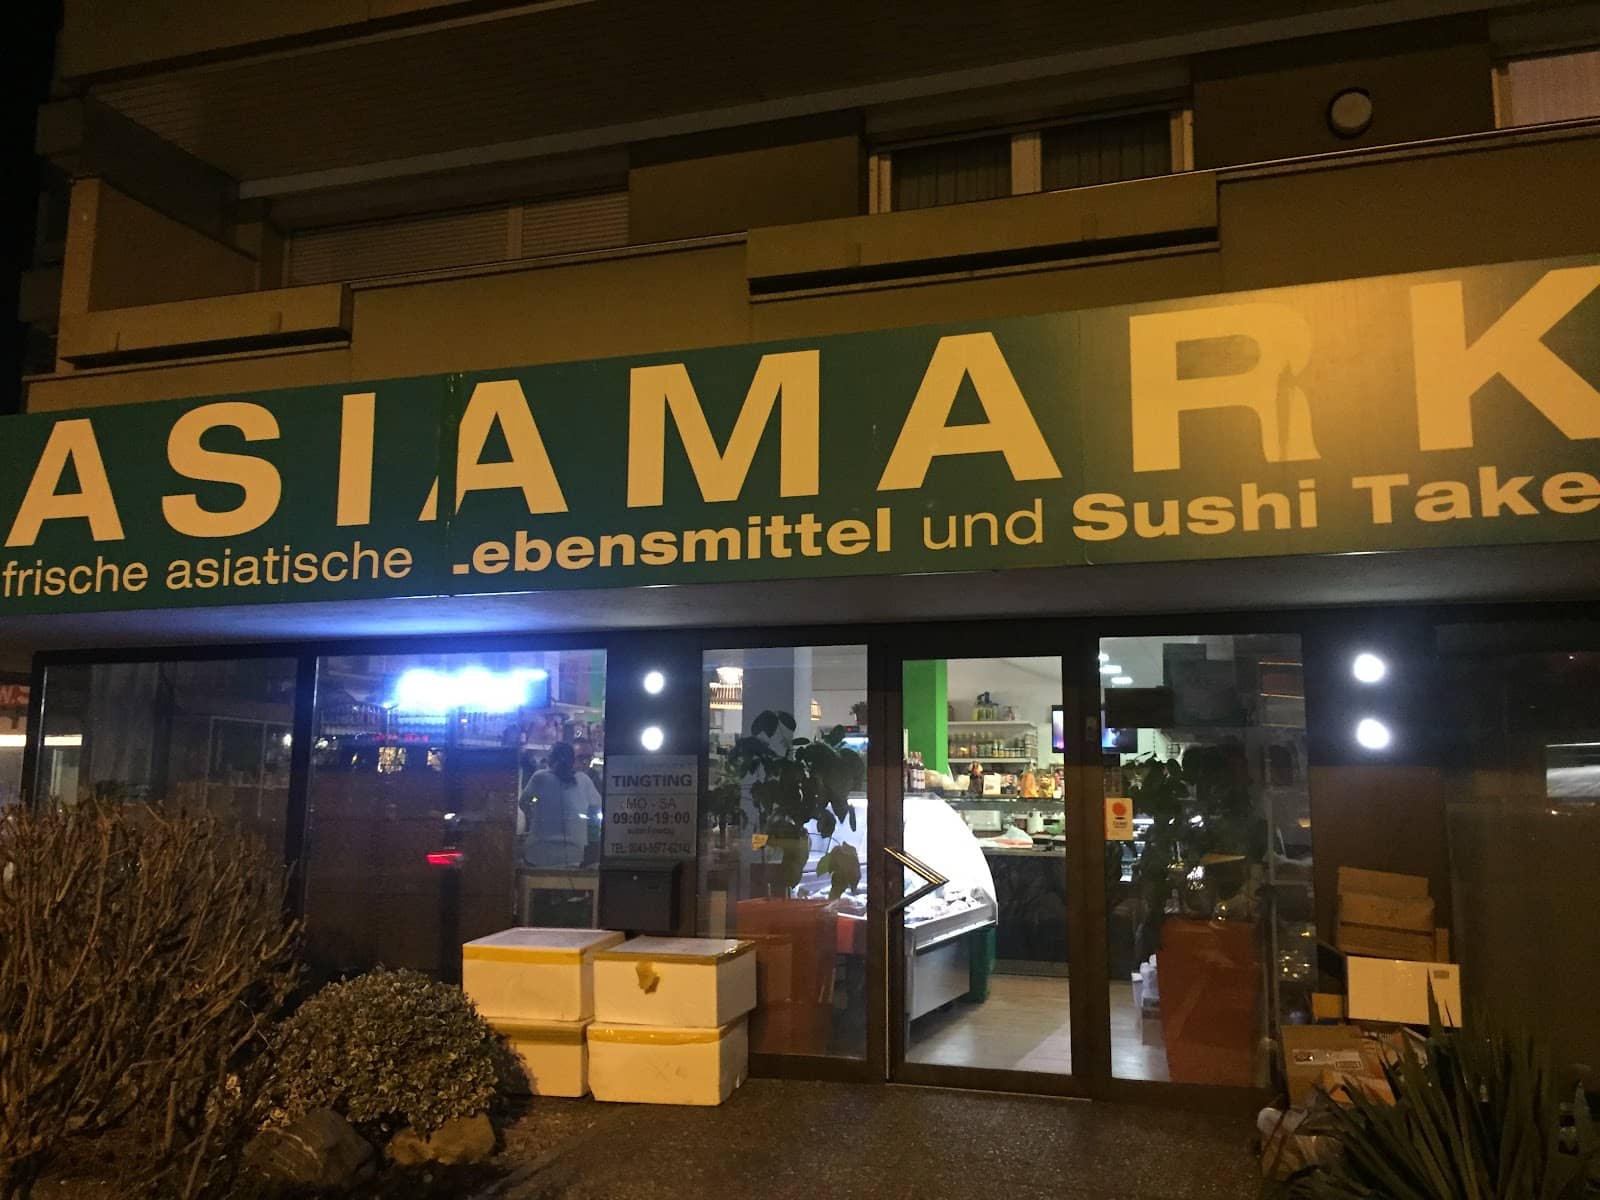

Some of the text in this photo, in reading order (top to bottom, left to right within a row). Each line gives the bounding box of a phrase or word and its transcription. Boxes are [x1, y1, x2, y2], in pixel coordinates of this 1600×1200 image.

[2, 556, 149, 597] frische
[165, 540, 413, 591] asiatische
[452, 507, 892, 576] ebensmittel
[922, 498, 1044, 551] und
[1072, 478, 1319, 542] Sushi
[611, 774, 692, 788] TINGTING
